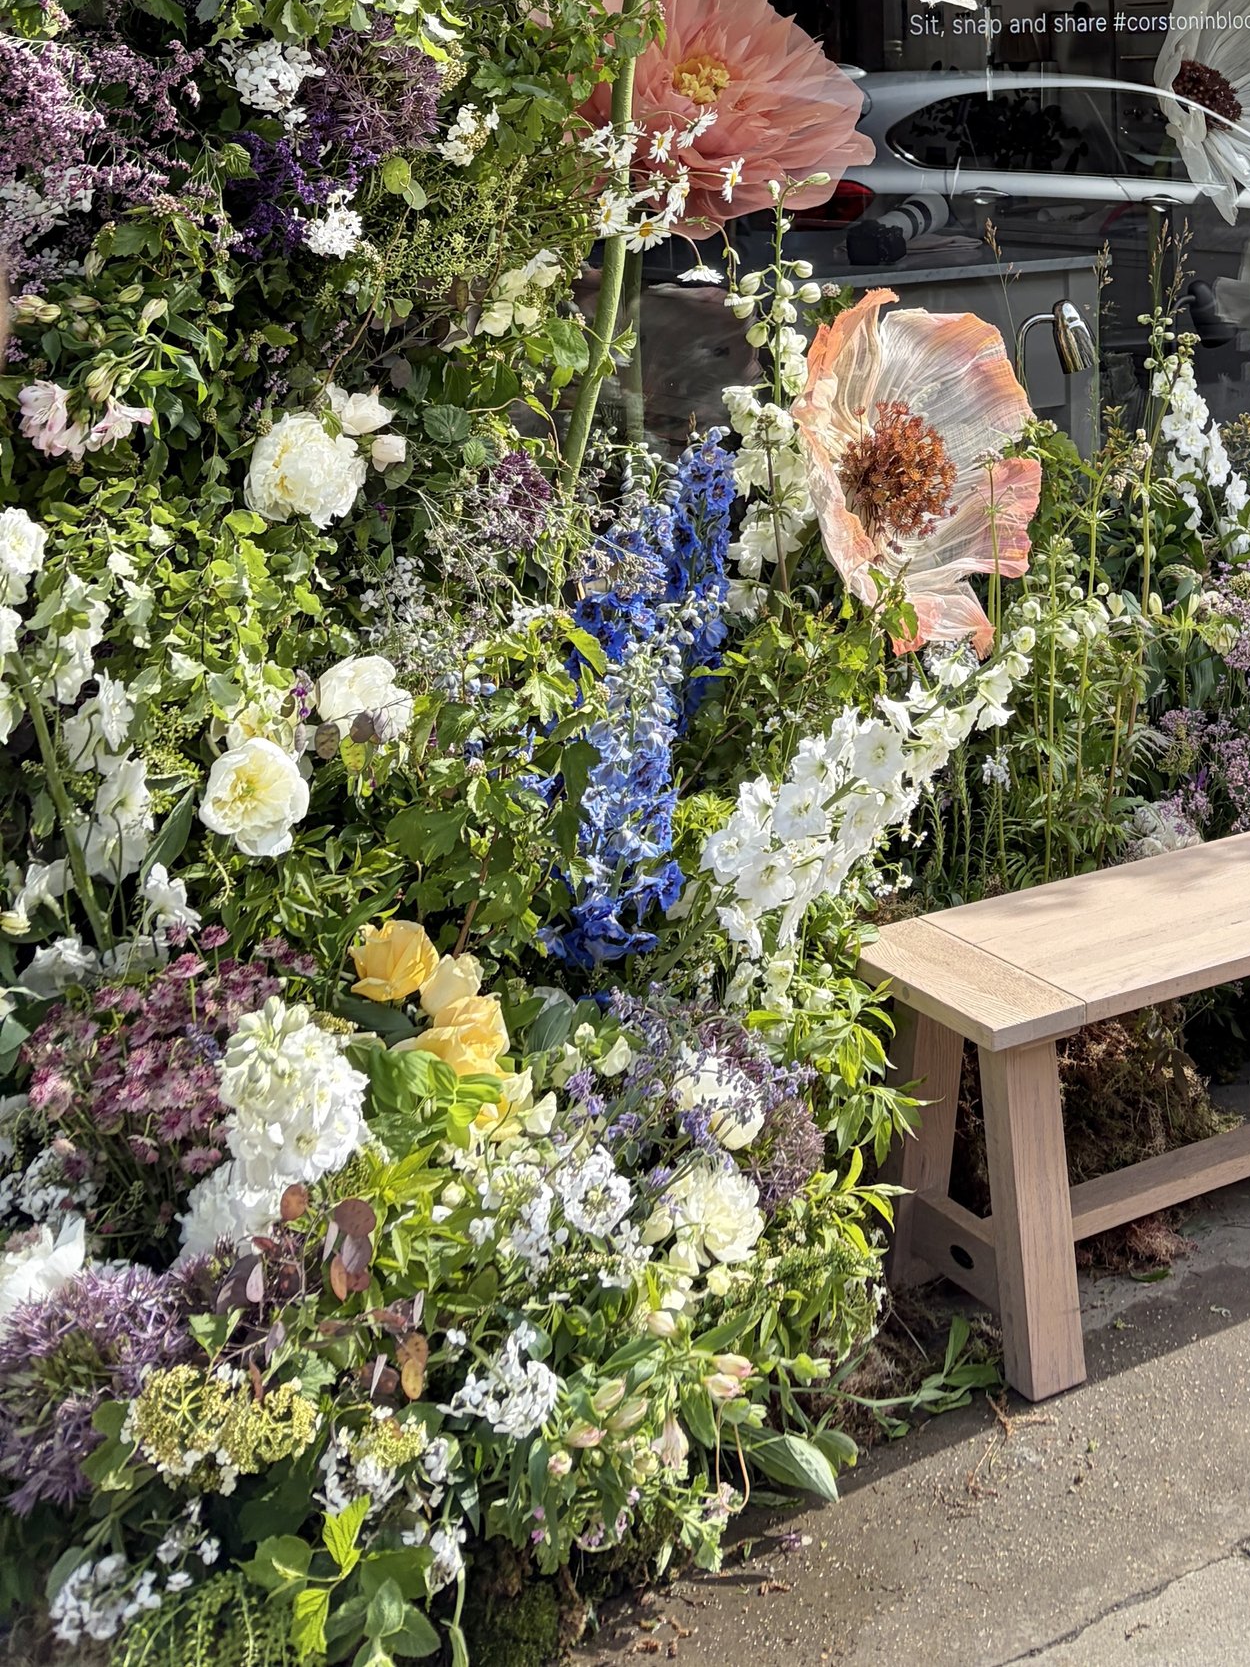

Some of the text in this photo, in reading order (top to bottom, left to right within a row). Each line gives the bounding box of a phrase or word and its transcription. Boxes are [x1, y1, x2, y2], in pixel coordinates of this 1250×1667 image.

[909, 14, 945, 38] Sit,
[952, 18, 1002, 38] snap
[1009, 13, 1046, 34] and
[1053, 13, 1107, 33] share
